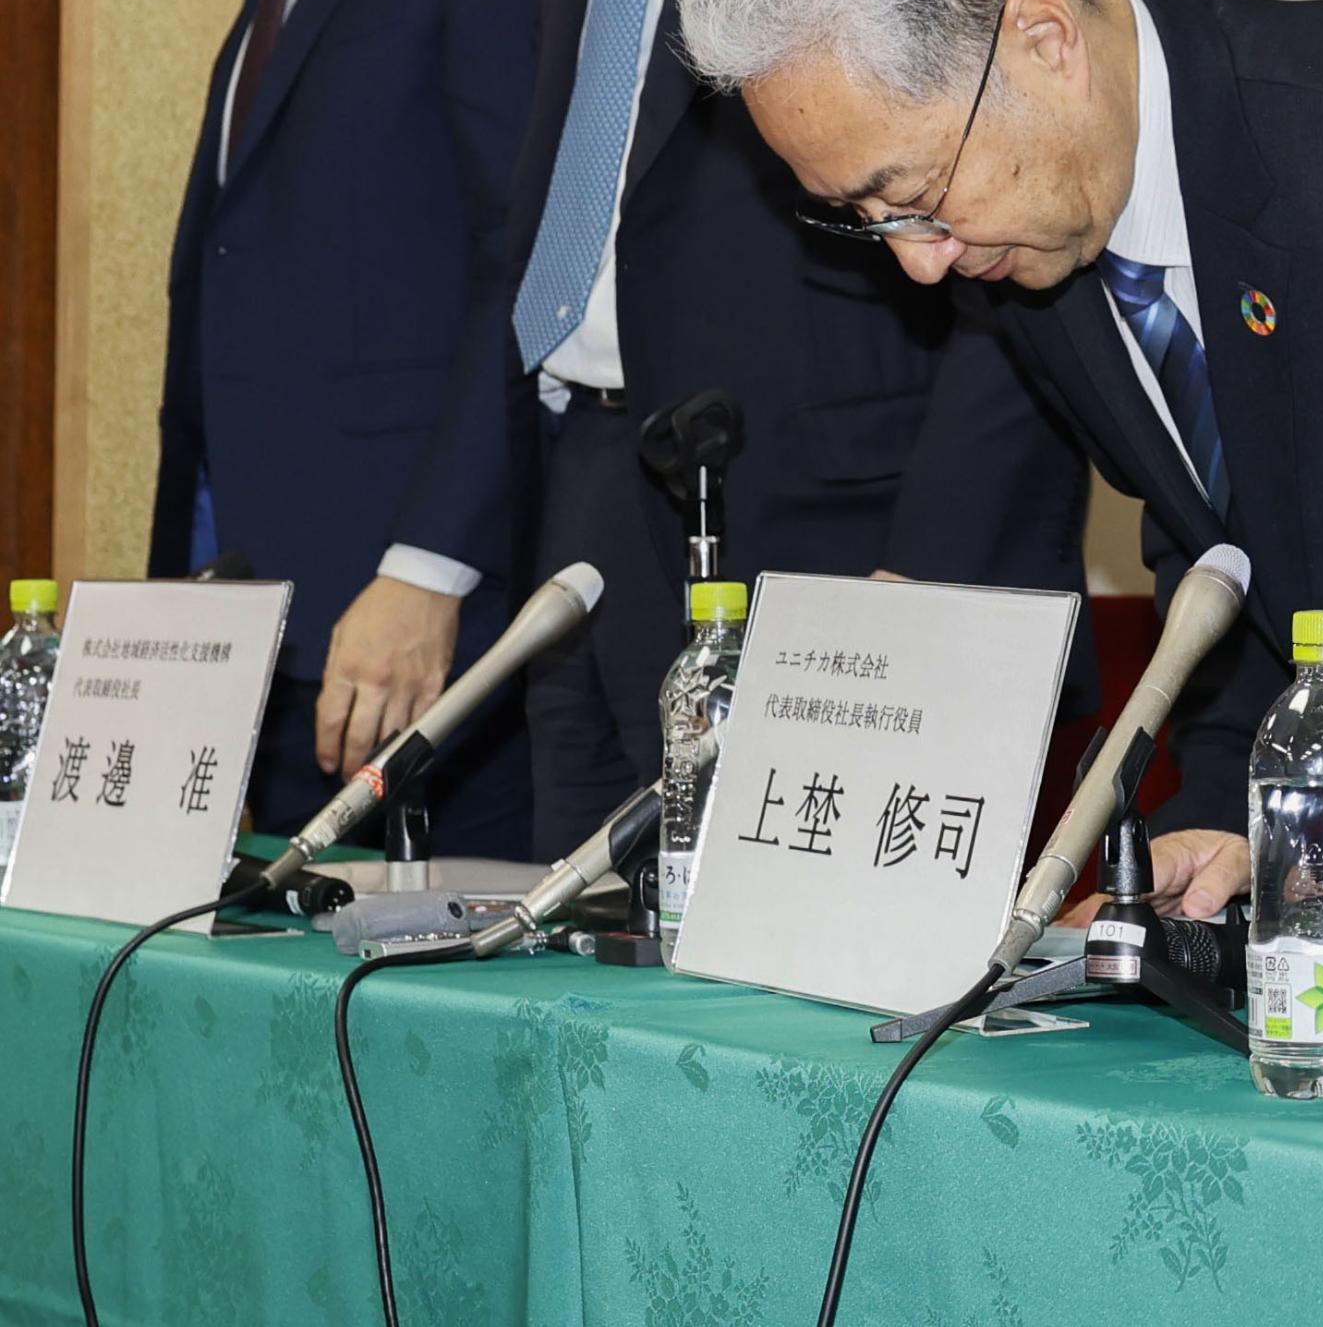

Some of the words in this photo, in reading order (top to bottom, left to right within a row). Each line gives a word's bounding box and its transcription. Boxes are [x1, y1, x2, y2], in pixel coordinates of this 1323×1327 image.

[776, 649, 889, 679] ユニチカ株式会社
[764, 693, 923, 734] 代表取締役社長執行役員
[738, 768, 844, 856] 上埜
[873, 782, 986, 879] 修司
[1098, 924, 1125, 938] 101
